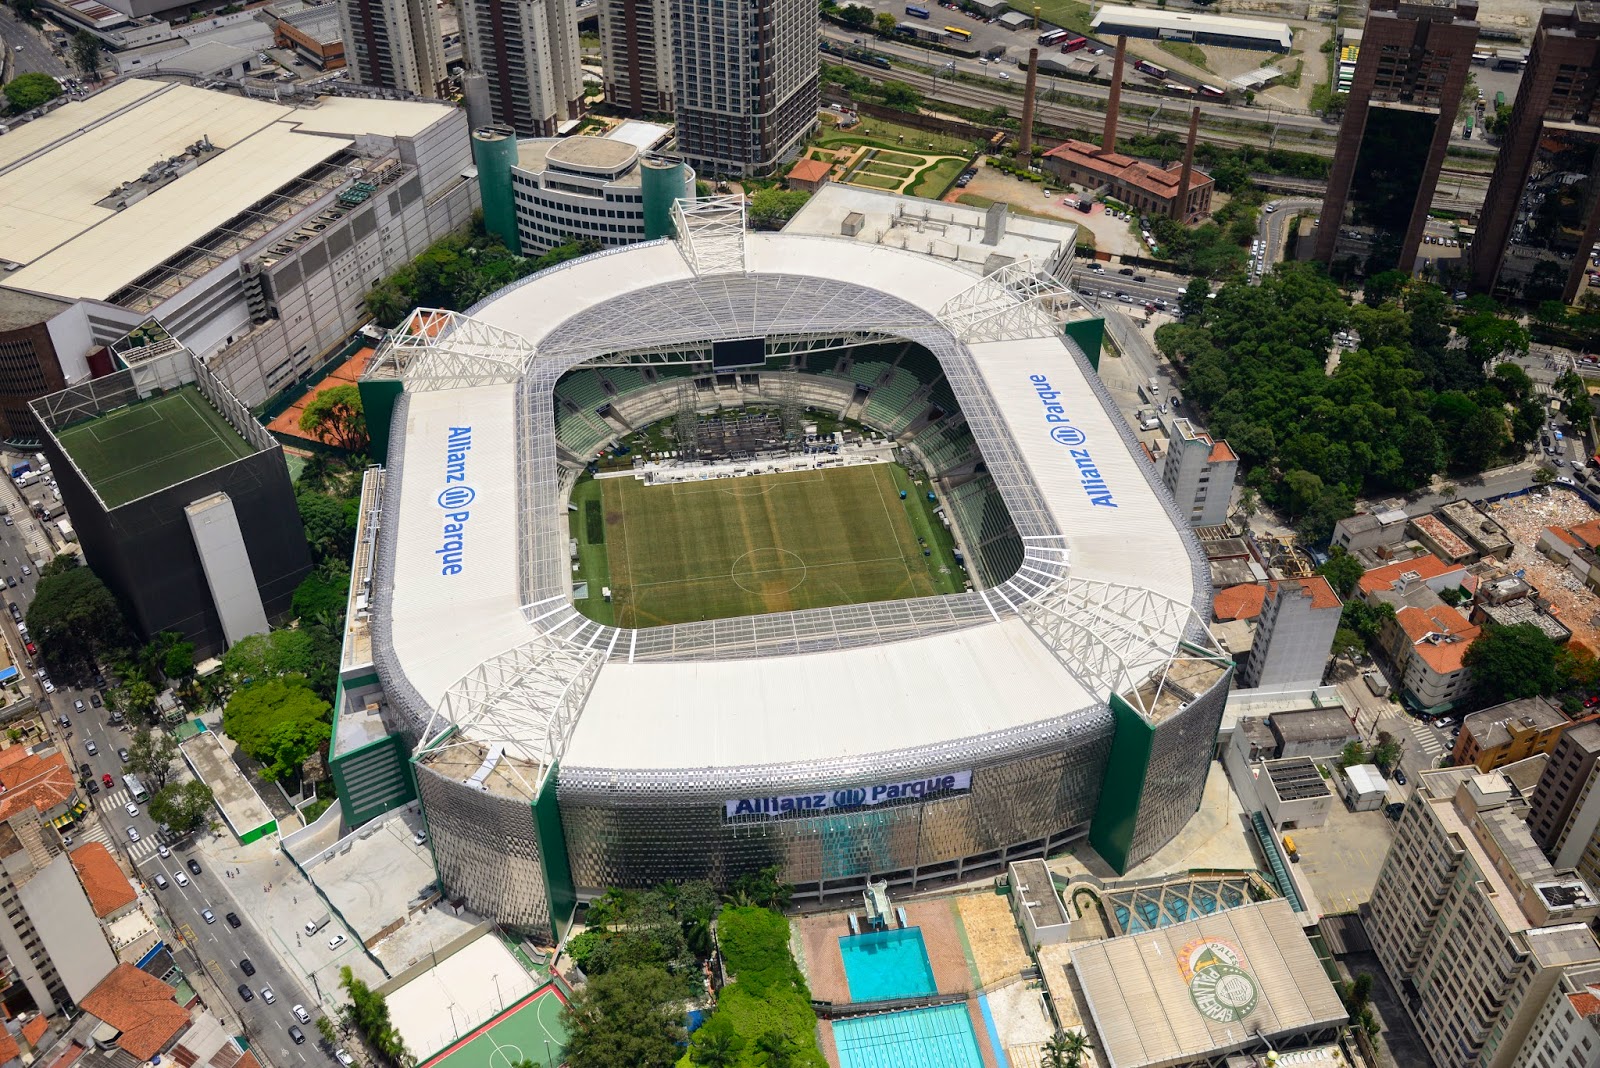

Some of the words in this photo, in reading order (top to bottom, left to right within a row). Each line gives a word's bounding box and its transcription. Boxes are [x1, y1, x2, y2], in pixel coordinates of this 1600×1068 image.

[1029, 374, 1070, 423] Parque
[446, 426, 472, 484] Allianz
[1069, 448, 1119, 508] Allianz
[435, 510, 470, 576] Parque
[734, 794, 827, 815] Allianz
[871, 775, 956, 800] Parque
[1190, 967, 1234, 1022] PALMEIRAS
